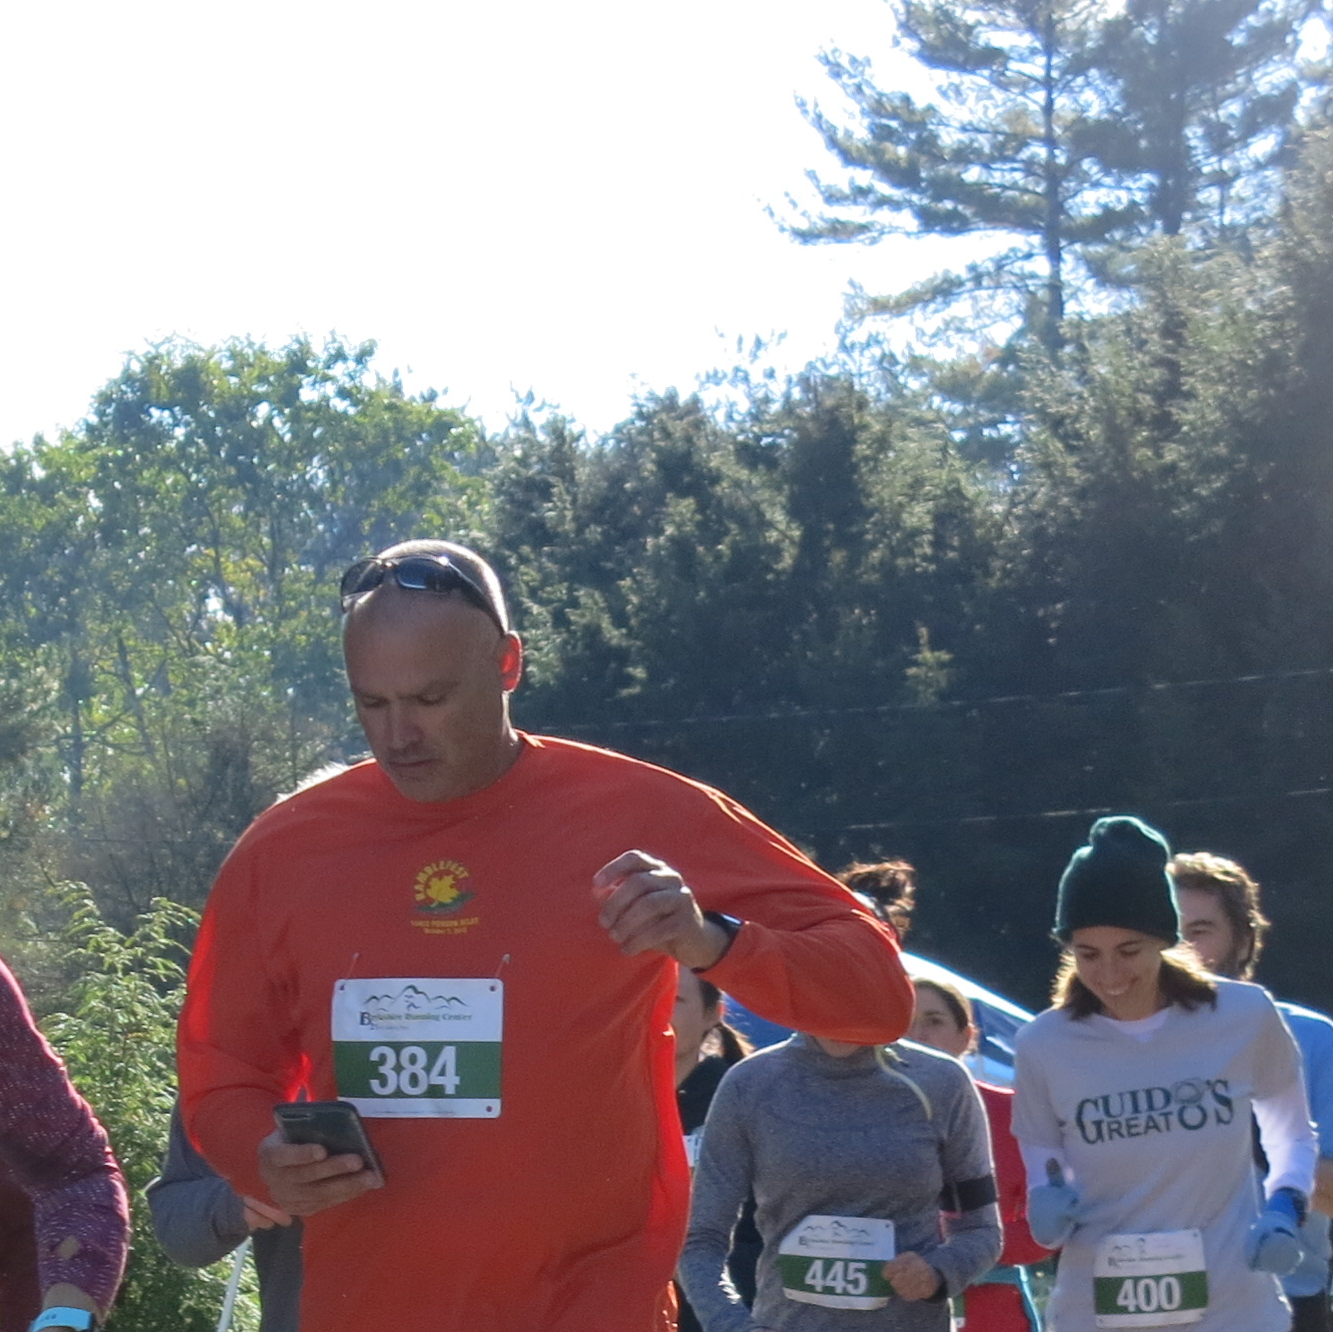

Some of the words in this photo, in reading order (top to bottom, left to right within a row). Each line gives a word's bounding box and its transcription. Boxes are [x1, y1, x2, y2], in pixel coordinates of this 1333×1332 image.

[369, 1045, 461, 1096] 384
[804, 1259, 867, 1296] 445
[1116, 1276, 1181, 1312] 400
